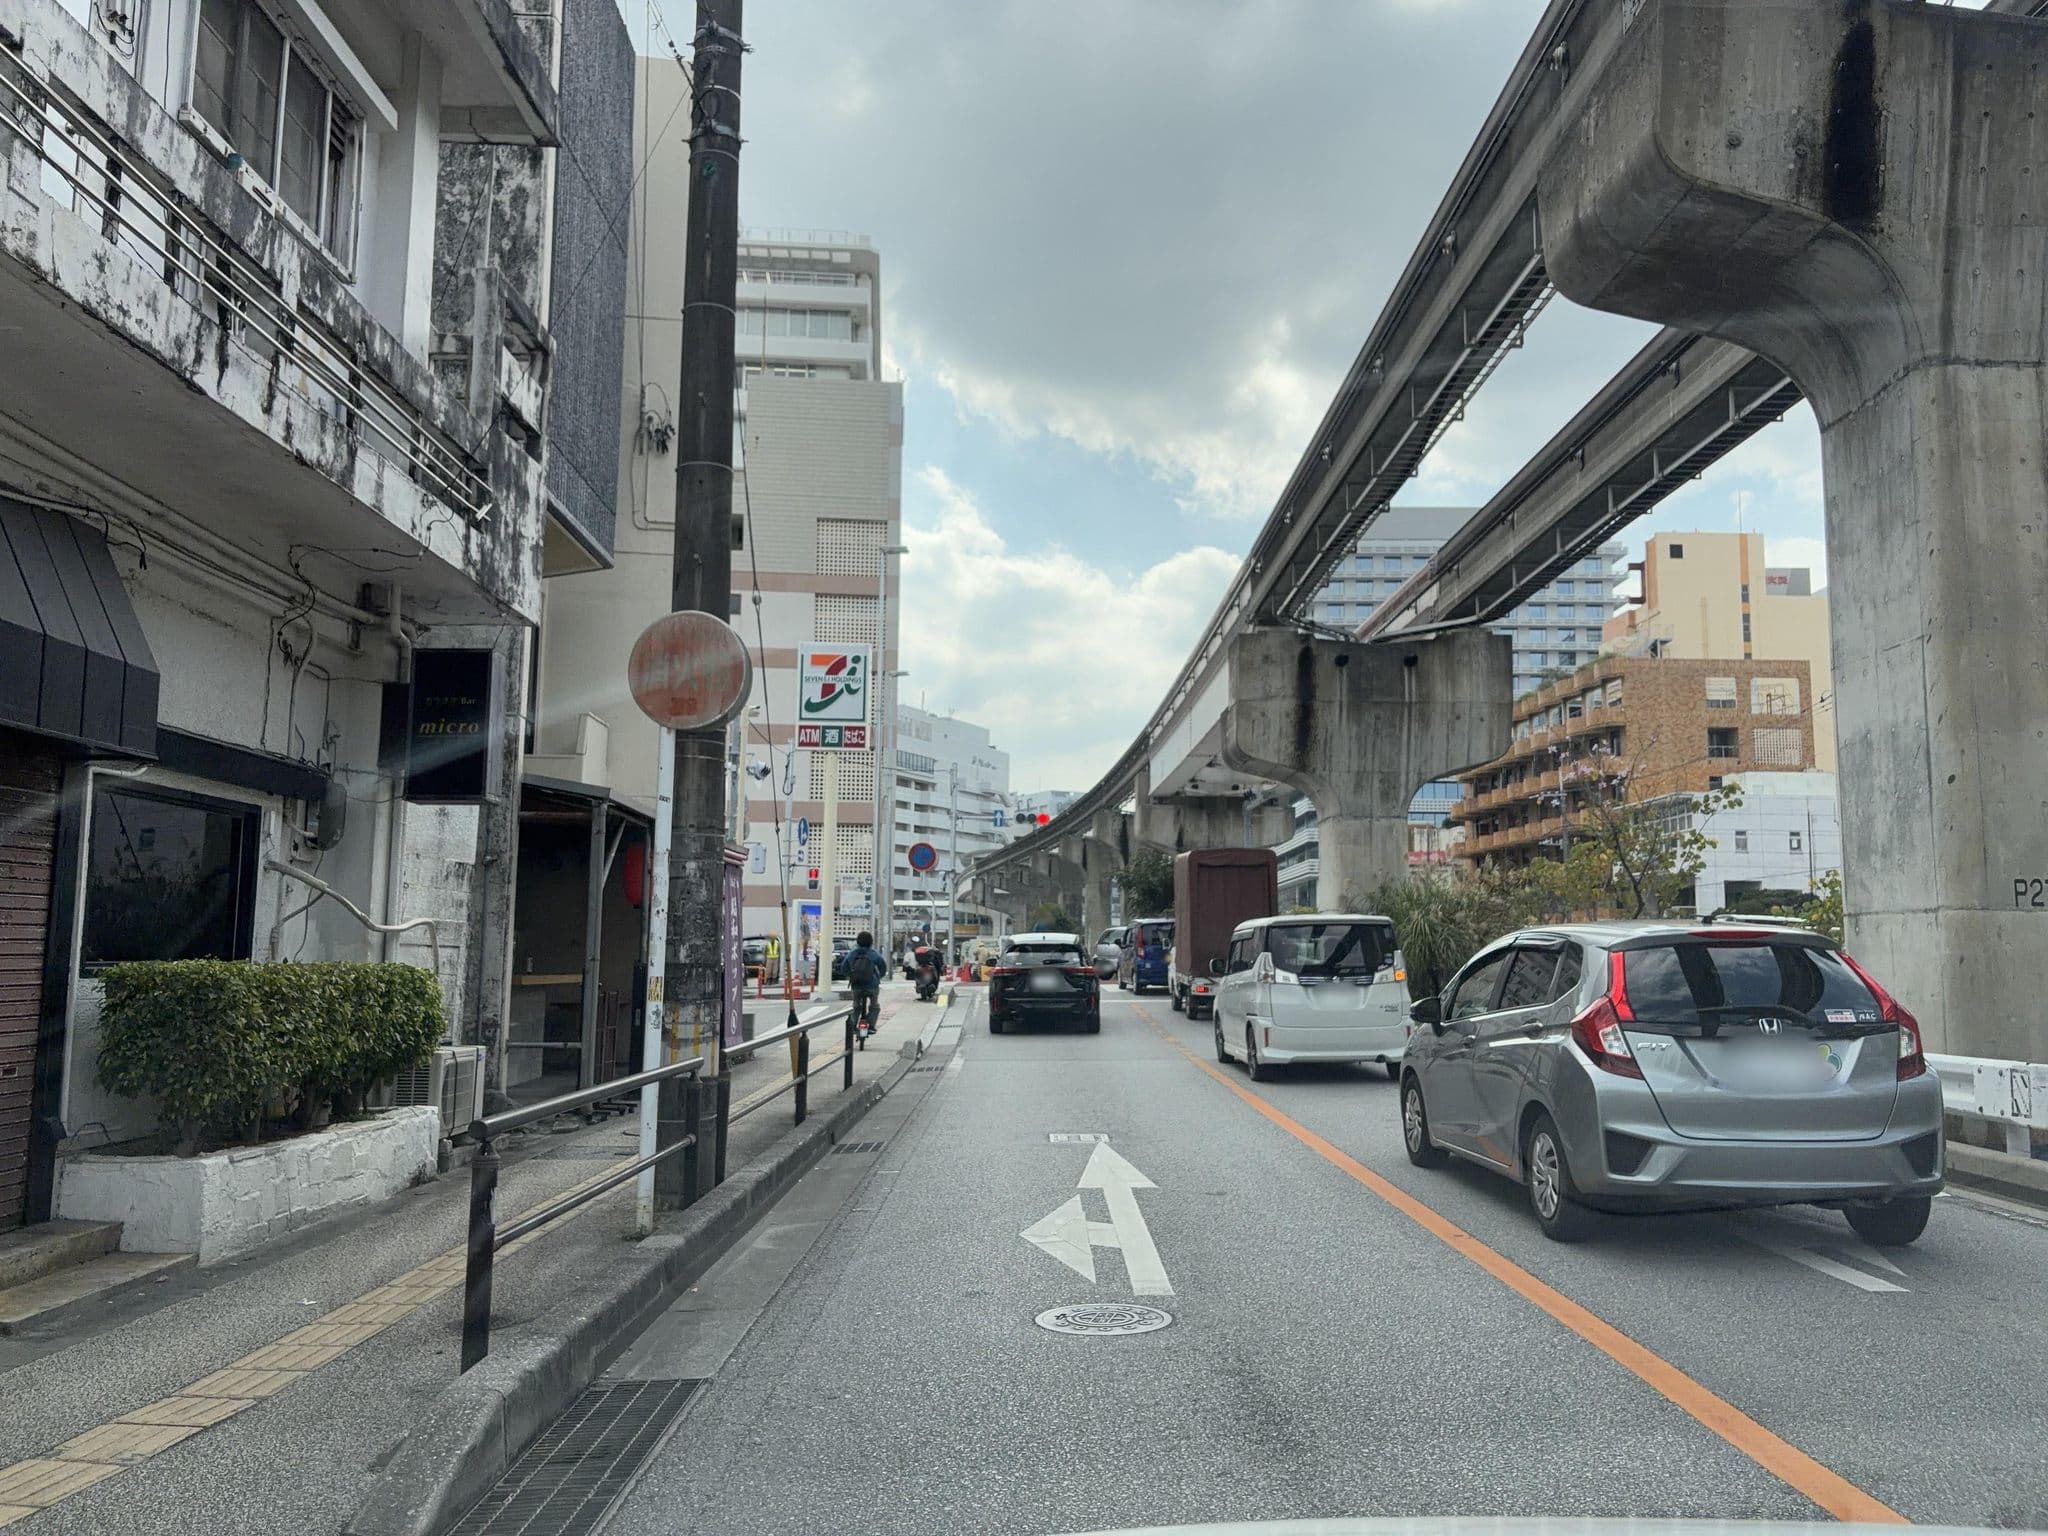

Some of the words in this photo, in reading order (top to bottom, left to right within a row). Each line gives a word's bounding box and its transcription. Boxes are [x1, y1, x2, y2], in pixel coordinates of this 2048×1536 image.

[419, 718, 479, 734] micro
[799, 728, 820, 743] ATM
[824, 729, 839, 744] 酒
[844, 729, 865, 744] たばこ
[2014, 878, 2048, 907] P2
[1636, 1041, 1672, 1051] FIT
